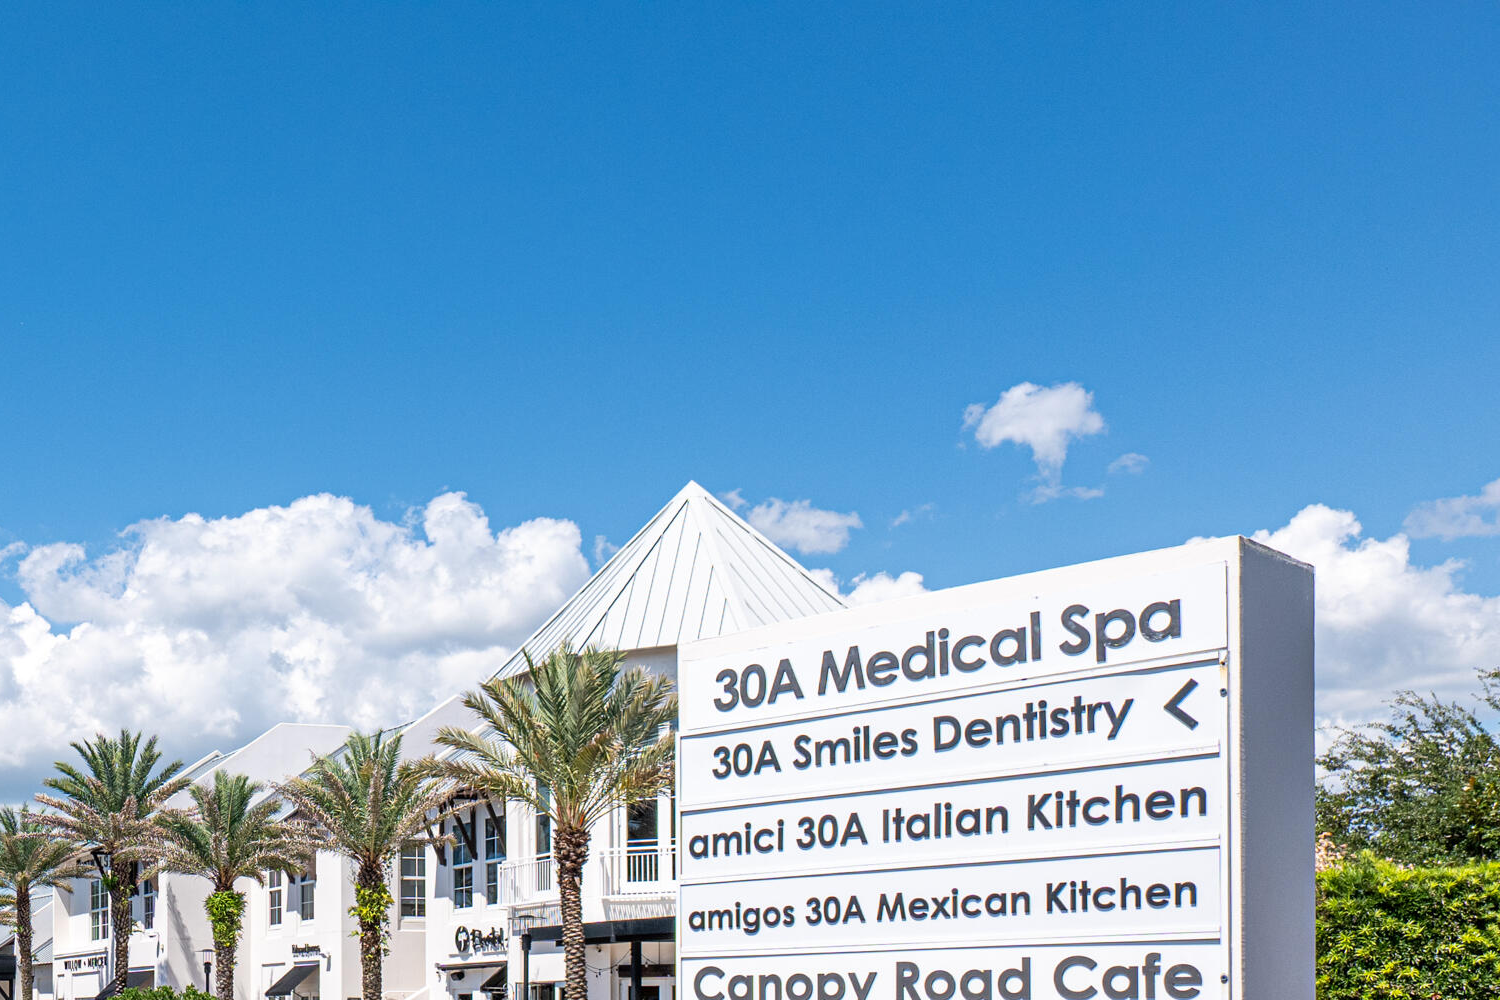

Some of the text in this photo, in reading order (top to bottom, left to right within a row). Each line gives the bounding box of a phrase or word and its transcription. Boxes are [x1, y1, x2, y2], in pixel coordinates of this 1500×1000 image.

[713, 599, 1181, 712] 30A Medical Spa
[712, 695, 1134, 779] 30A Smiles Dentistry
[688, 784, 1206, 858] amici 30A Italian Kitchen
[688, 877, 1197, 934] amigos 30A Mexican Kitchen
[1053, 952, 1203, 1000] Cafe
